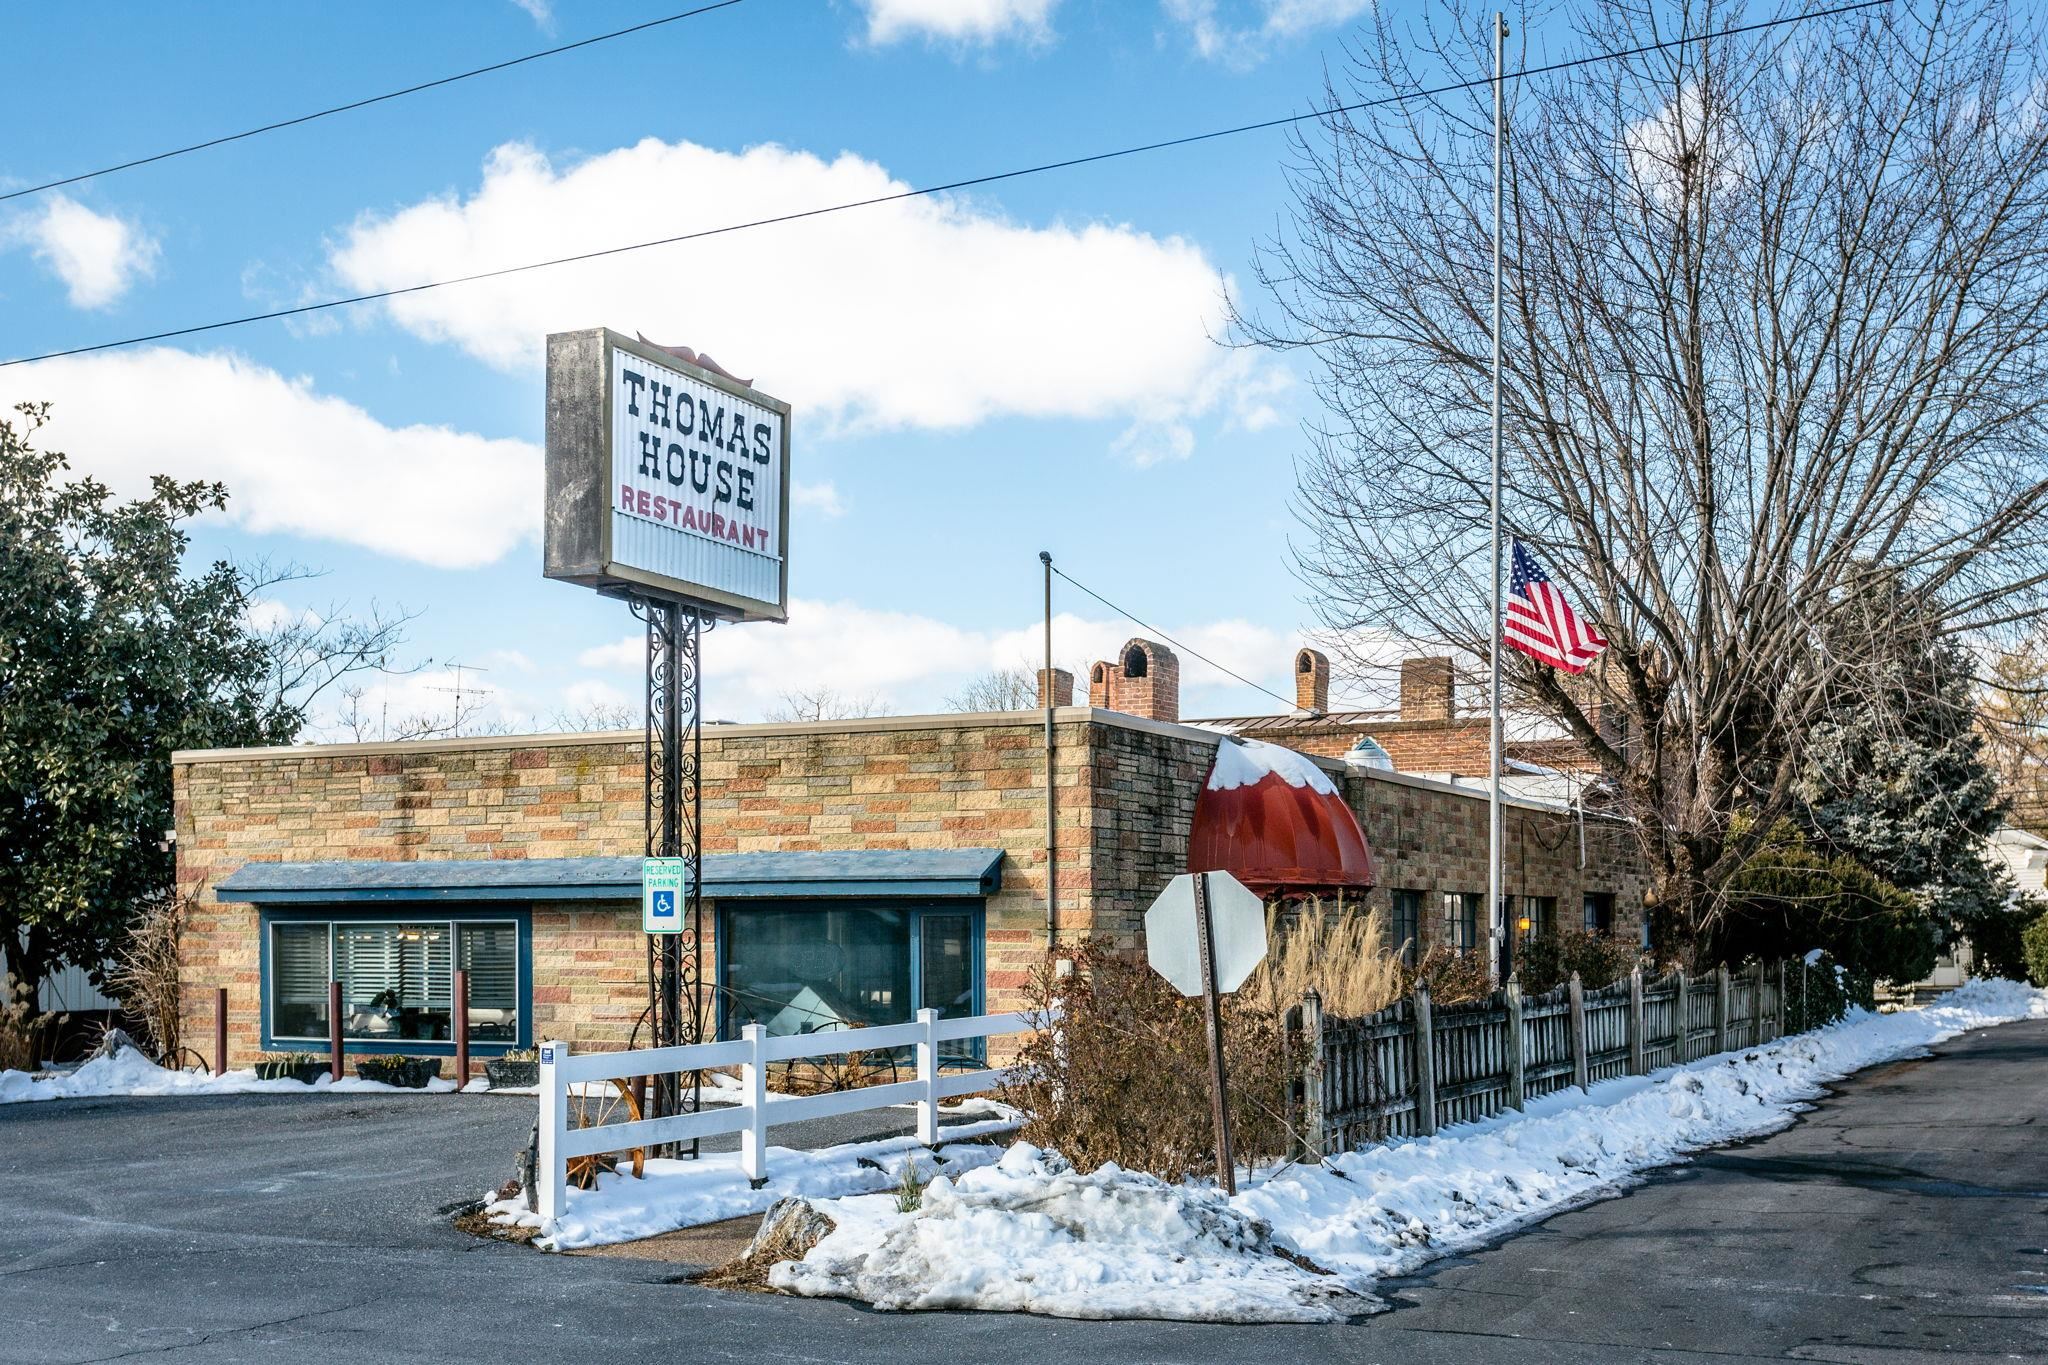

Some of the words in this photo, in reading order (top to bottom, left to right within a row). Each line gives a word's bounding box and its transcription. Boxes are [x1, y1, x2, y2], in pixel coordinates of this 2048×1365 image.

[622, 368, 772, 465] THOMAS
[639, 430, 754, 511] HOUSE
[621, 484, 769, 551] RESTAURANT
[646, 865, 681, 875] RESERVED
[648, 878, 679, 888] PARKING
